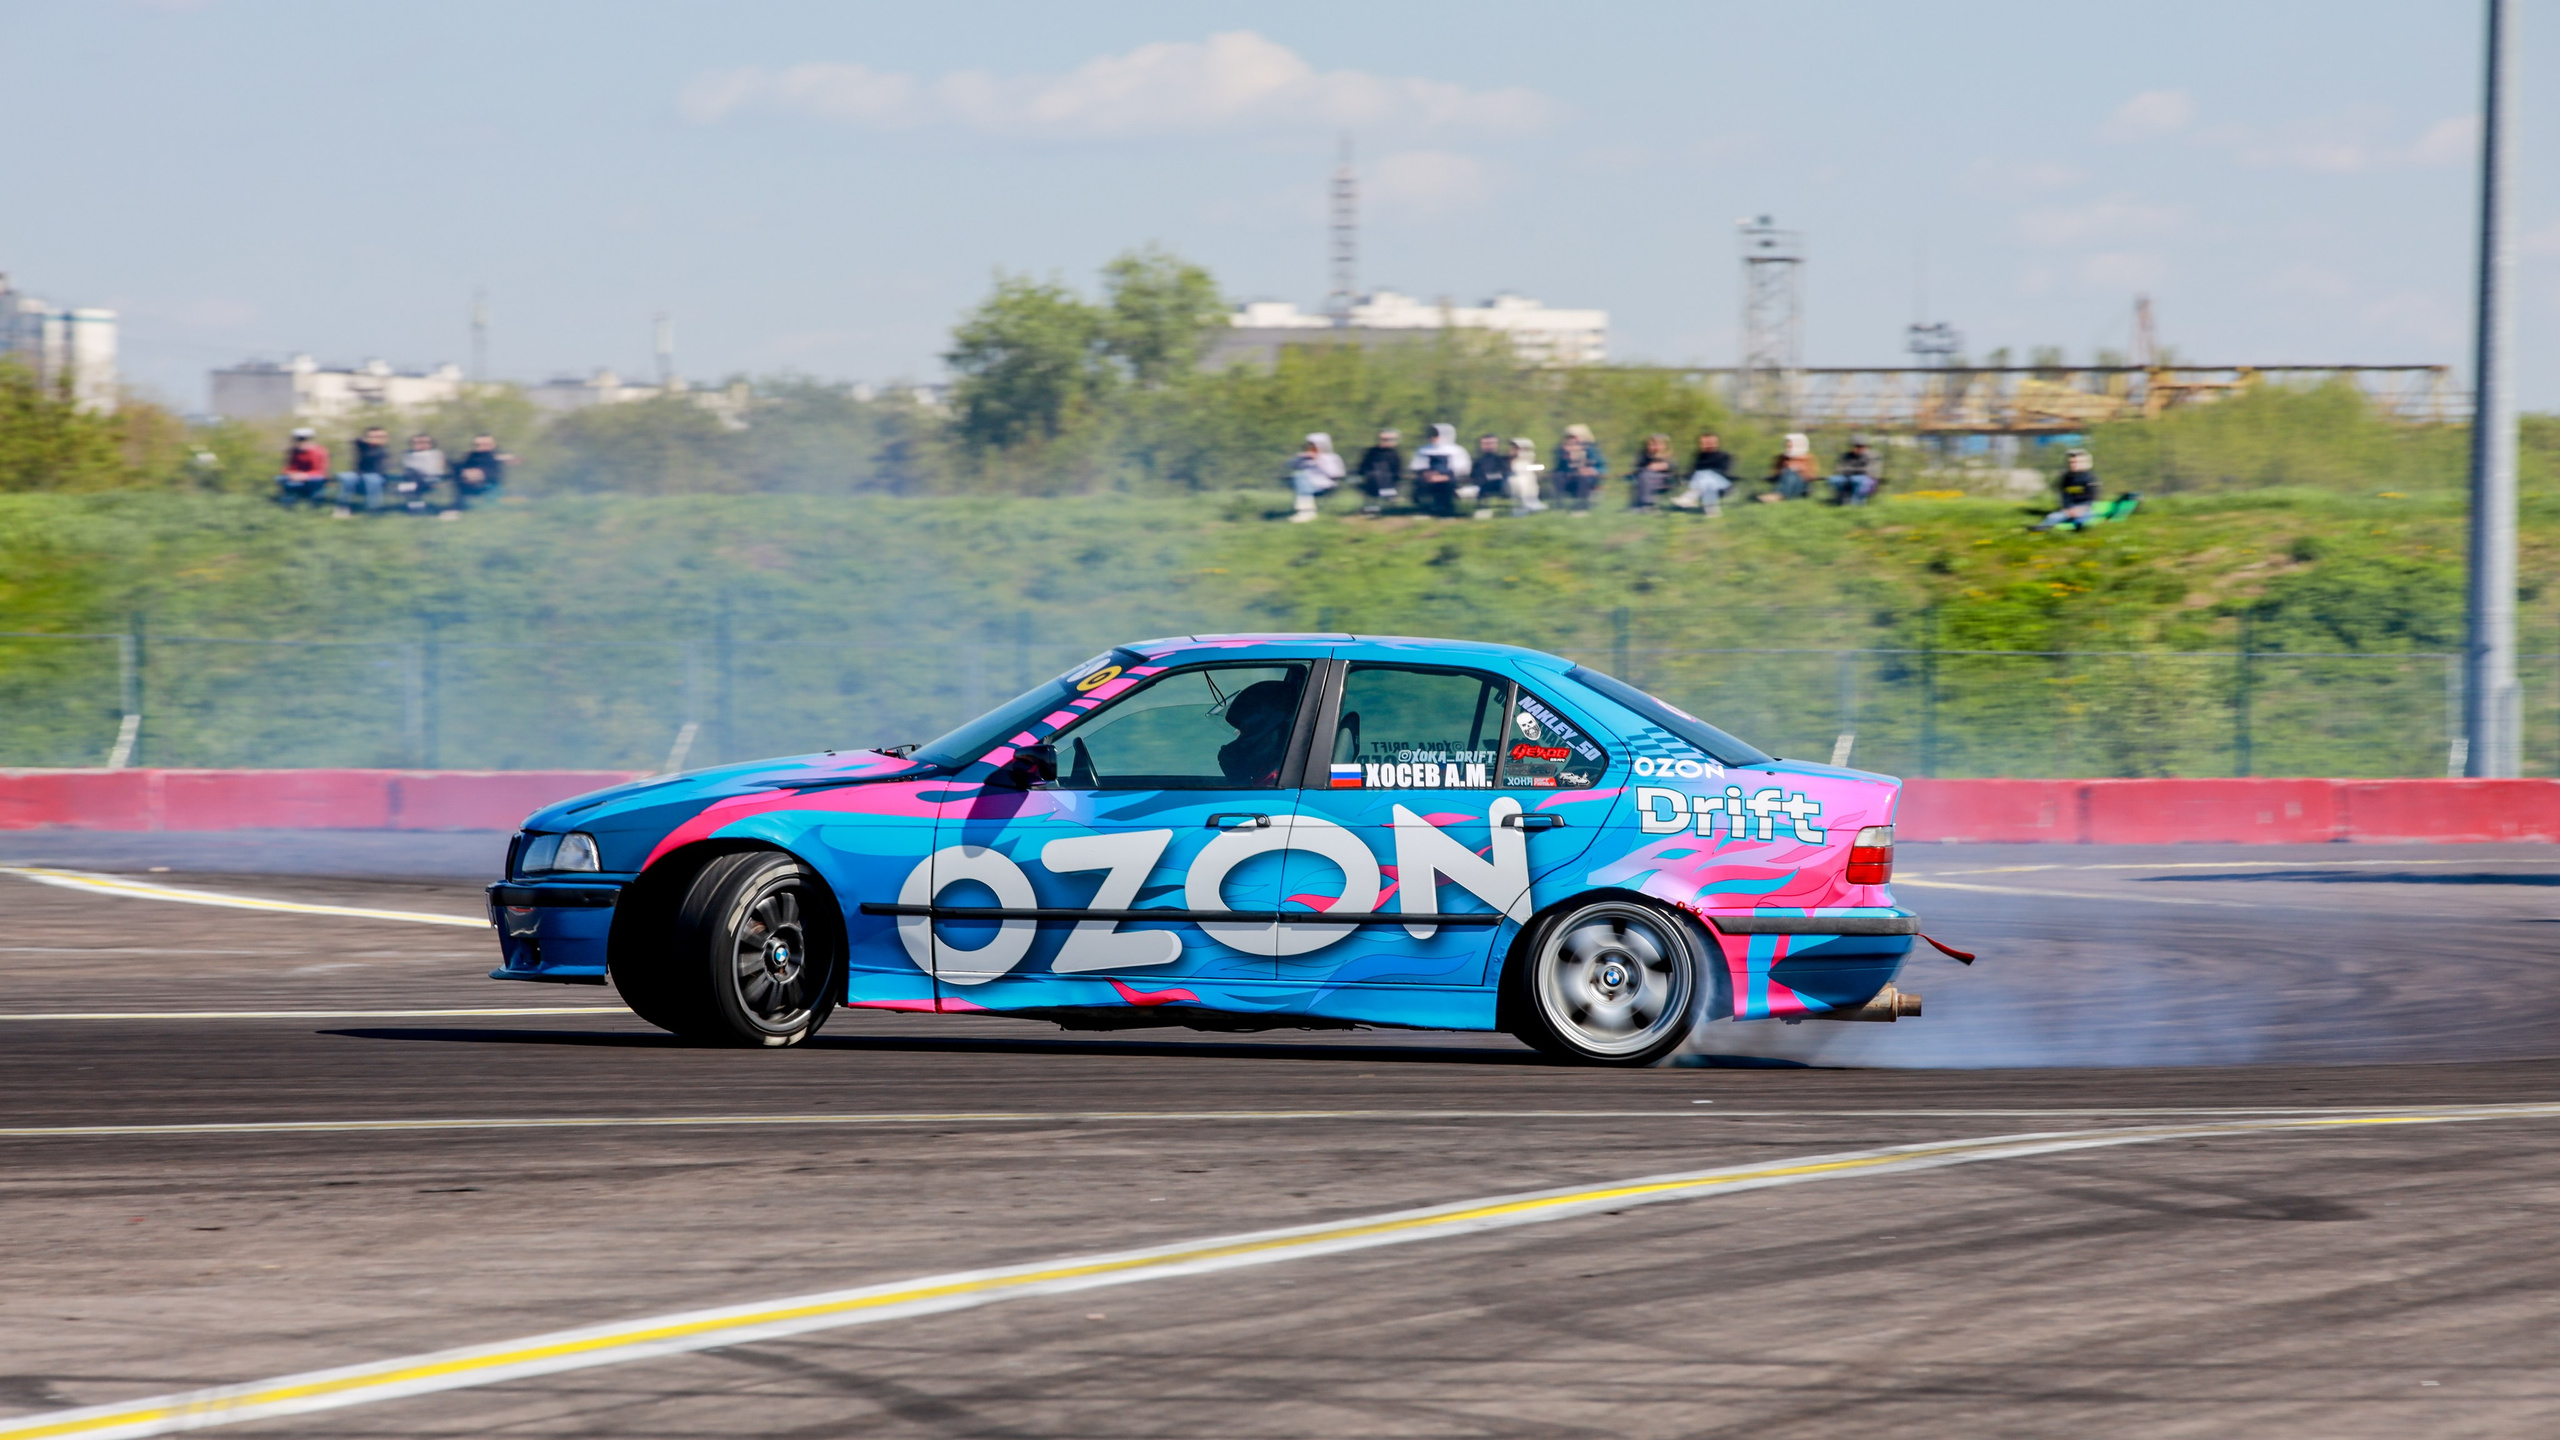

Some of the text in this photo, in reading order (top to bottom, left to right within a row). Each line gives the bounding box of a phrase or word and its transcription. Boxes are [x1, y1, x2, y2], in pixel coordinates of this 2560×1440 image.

[1517, 695, 1602, 762] NAKLEY_50
[1365, 763, 1441, 788] ХОСЕВ
[1444, 763, 1493, 788] А.М.
[1634, 756, 1725, 779] OZON
[1635, 786, 1826, 845] Drift
[897, 797, 1532, 985] OZON
